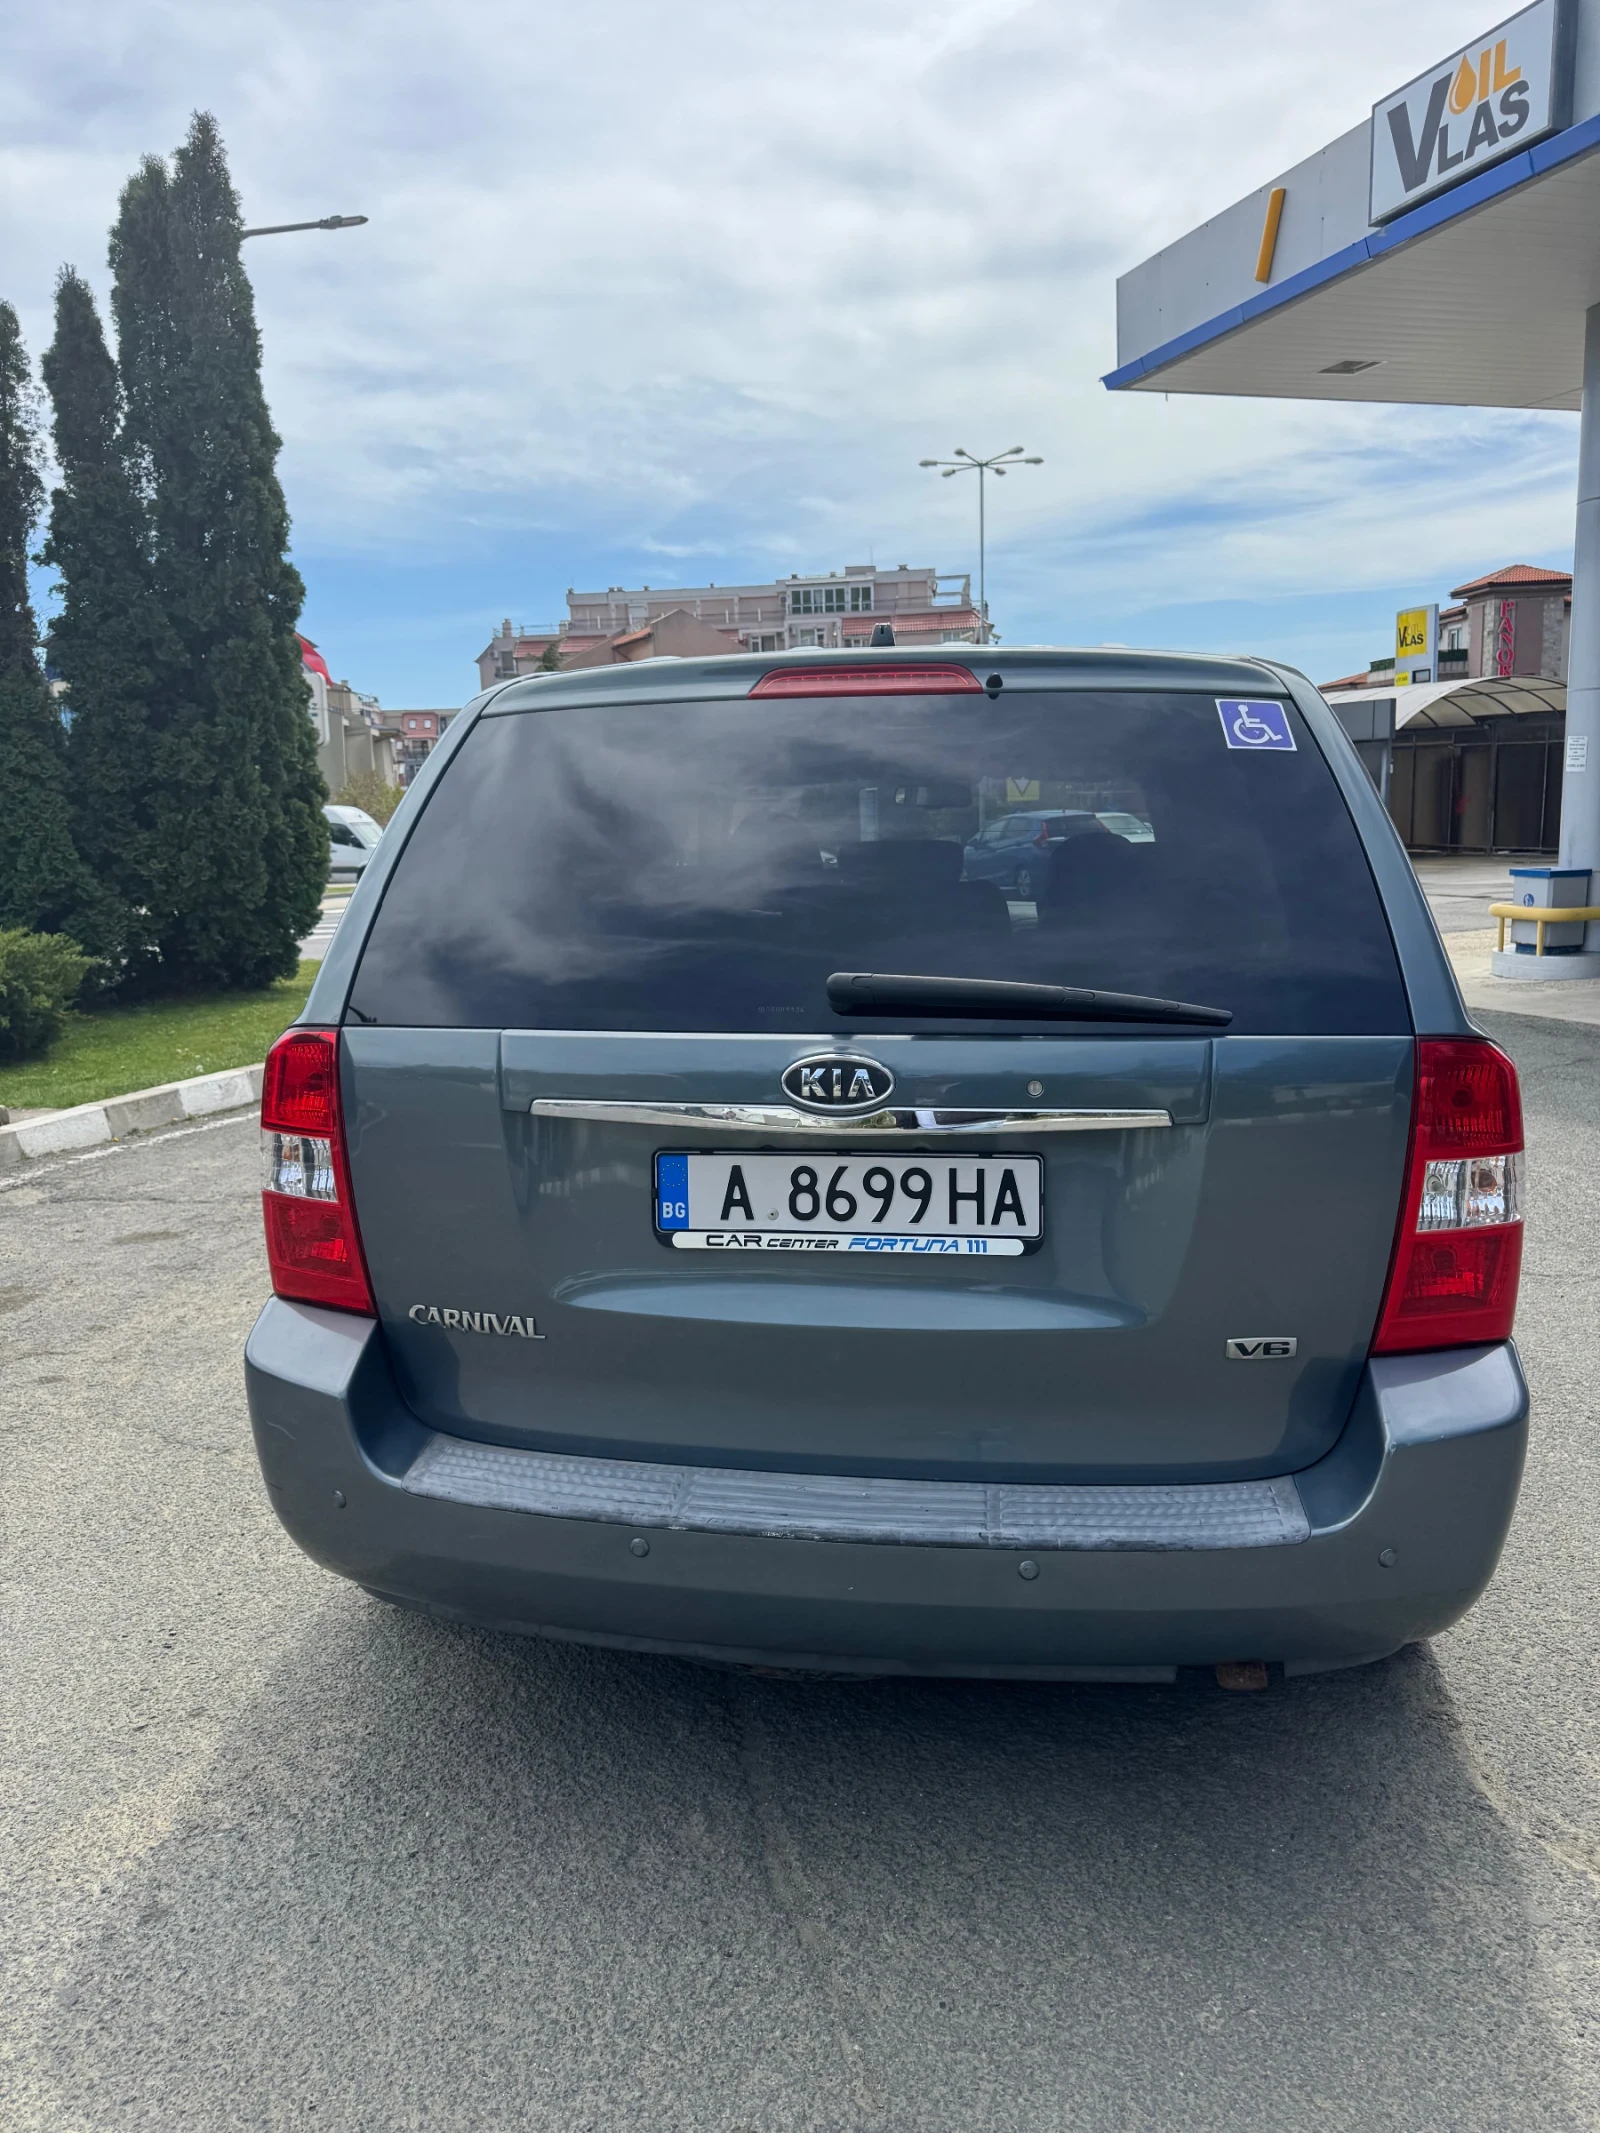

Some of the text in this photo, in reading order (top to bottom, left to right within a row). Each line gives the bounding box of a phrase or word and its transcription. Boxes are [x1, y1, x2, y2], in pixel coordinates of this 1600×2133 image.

[1386, 71, 1530, 193] VLAS
[1398, 625, 1424, 648] VLAS
[799, 1067, 876, 1098] KIA
[787, 1165, 933, 1224] 8699
[948, 1167, 1027, 1227] HA
[662, 1201, 686, 1219] BG
[705, 1234, 988, 1254] CAR CENTER FORTUNA 111
[408, 1304, 547, 1339] CARNIVAL
[1234, 1341, 1290, 1357] V6
